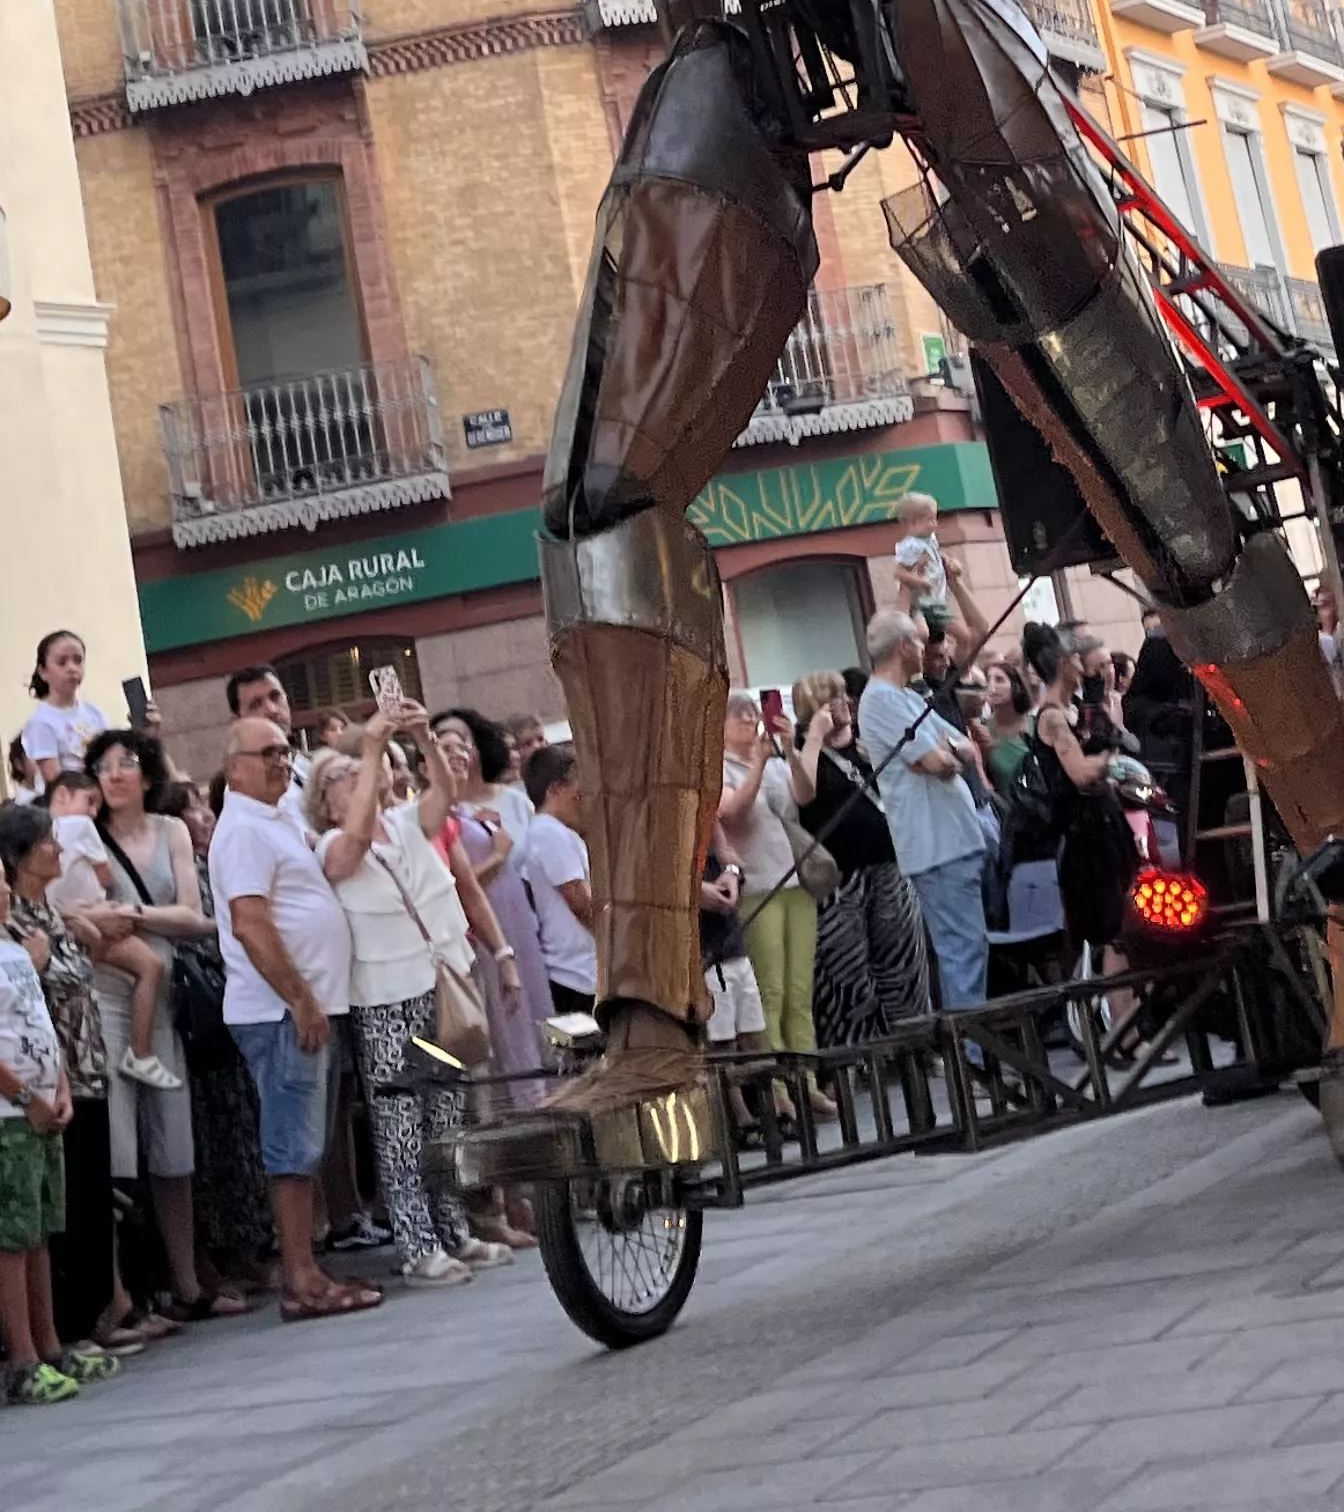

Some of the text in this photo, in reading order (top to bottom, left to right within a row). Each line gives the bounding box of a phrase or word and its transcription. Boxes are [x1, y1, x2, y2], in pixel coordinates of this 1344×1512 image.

[285, 547, 425, 592] CAJA RURAL
[305, 575, 414, 612] DE ARAGÓN
